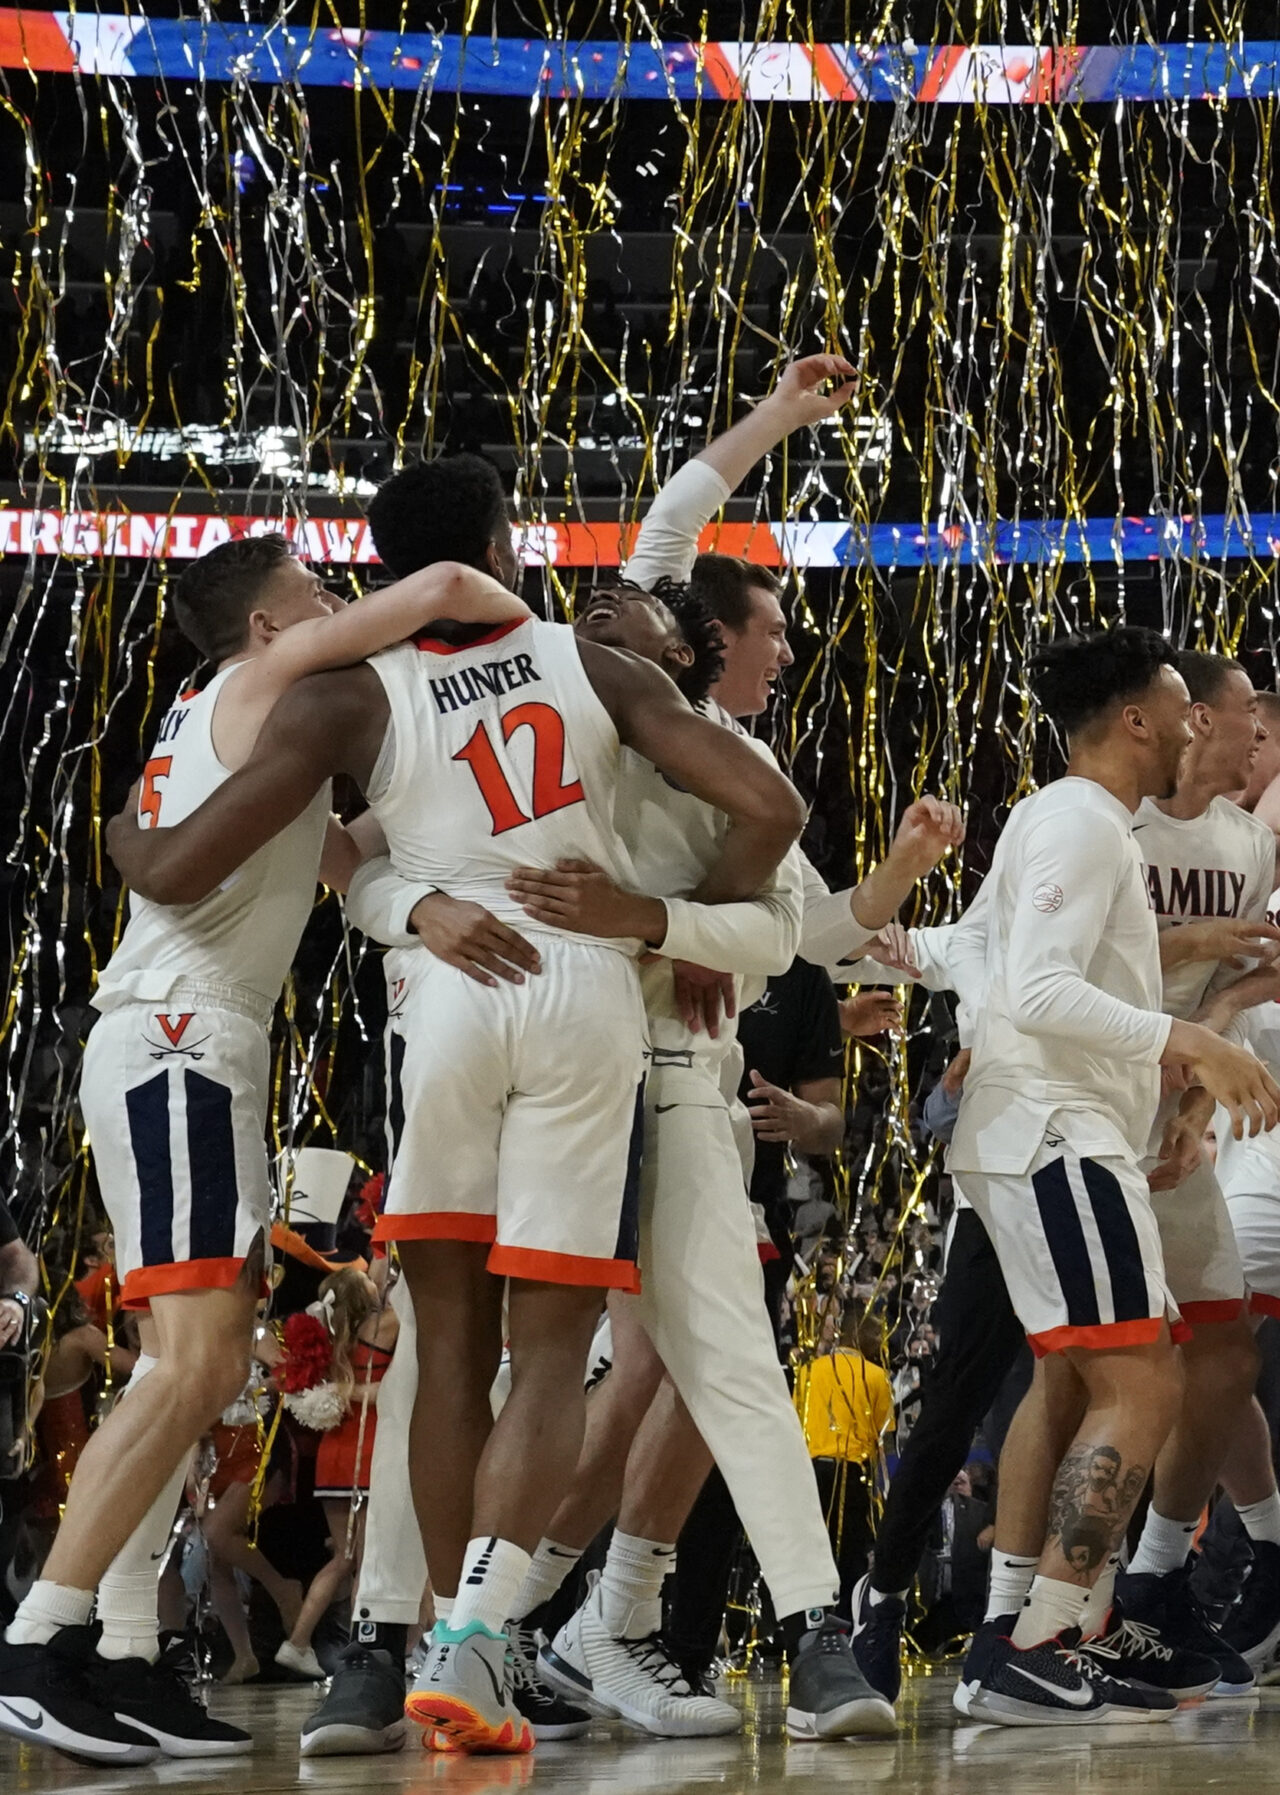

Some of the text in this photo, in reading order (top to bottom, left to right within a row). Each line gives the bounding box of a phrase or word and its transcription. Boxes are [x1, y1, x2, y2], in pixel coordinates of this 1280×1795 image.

[0, 511, 231, 558] IRGINIA
[429, 653, 541, 714] HUNTER
[451, 702, 586, 836] 12
[1147, 864, 1246, 918] AMILY
